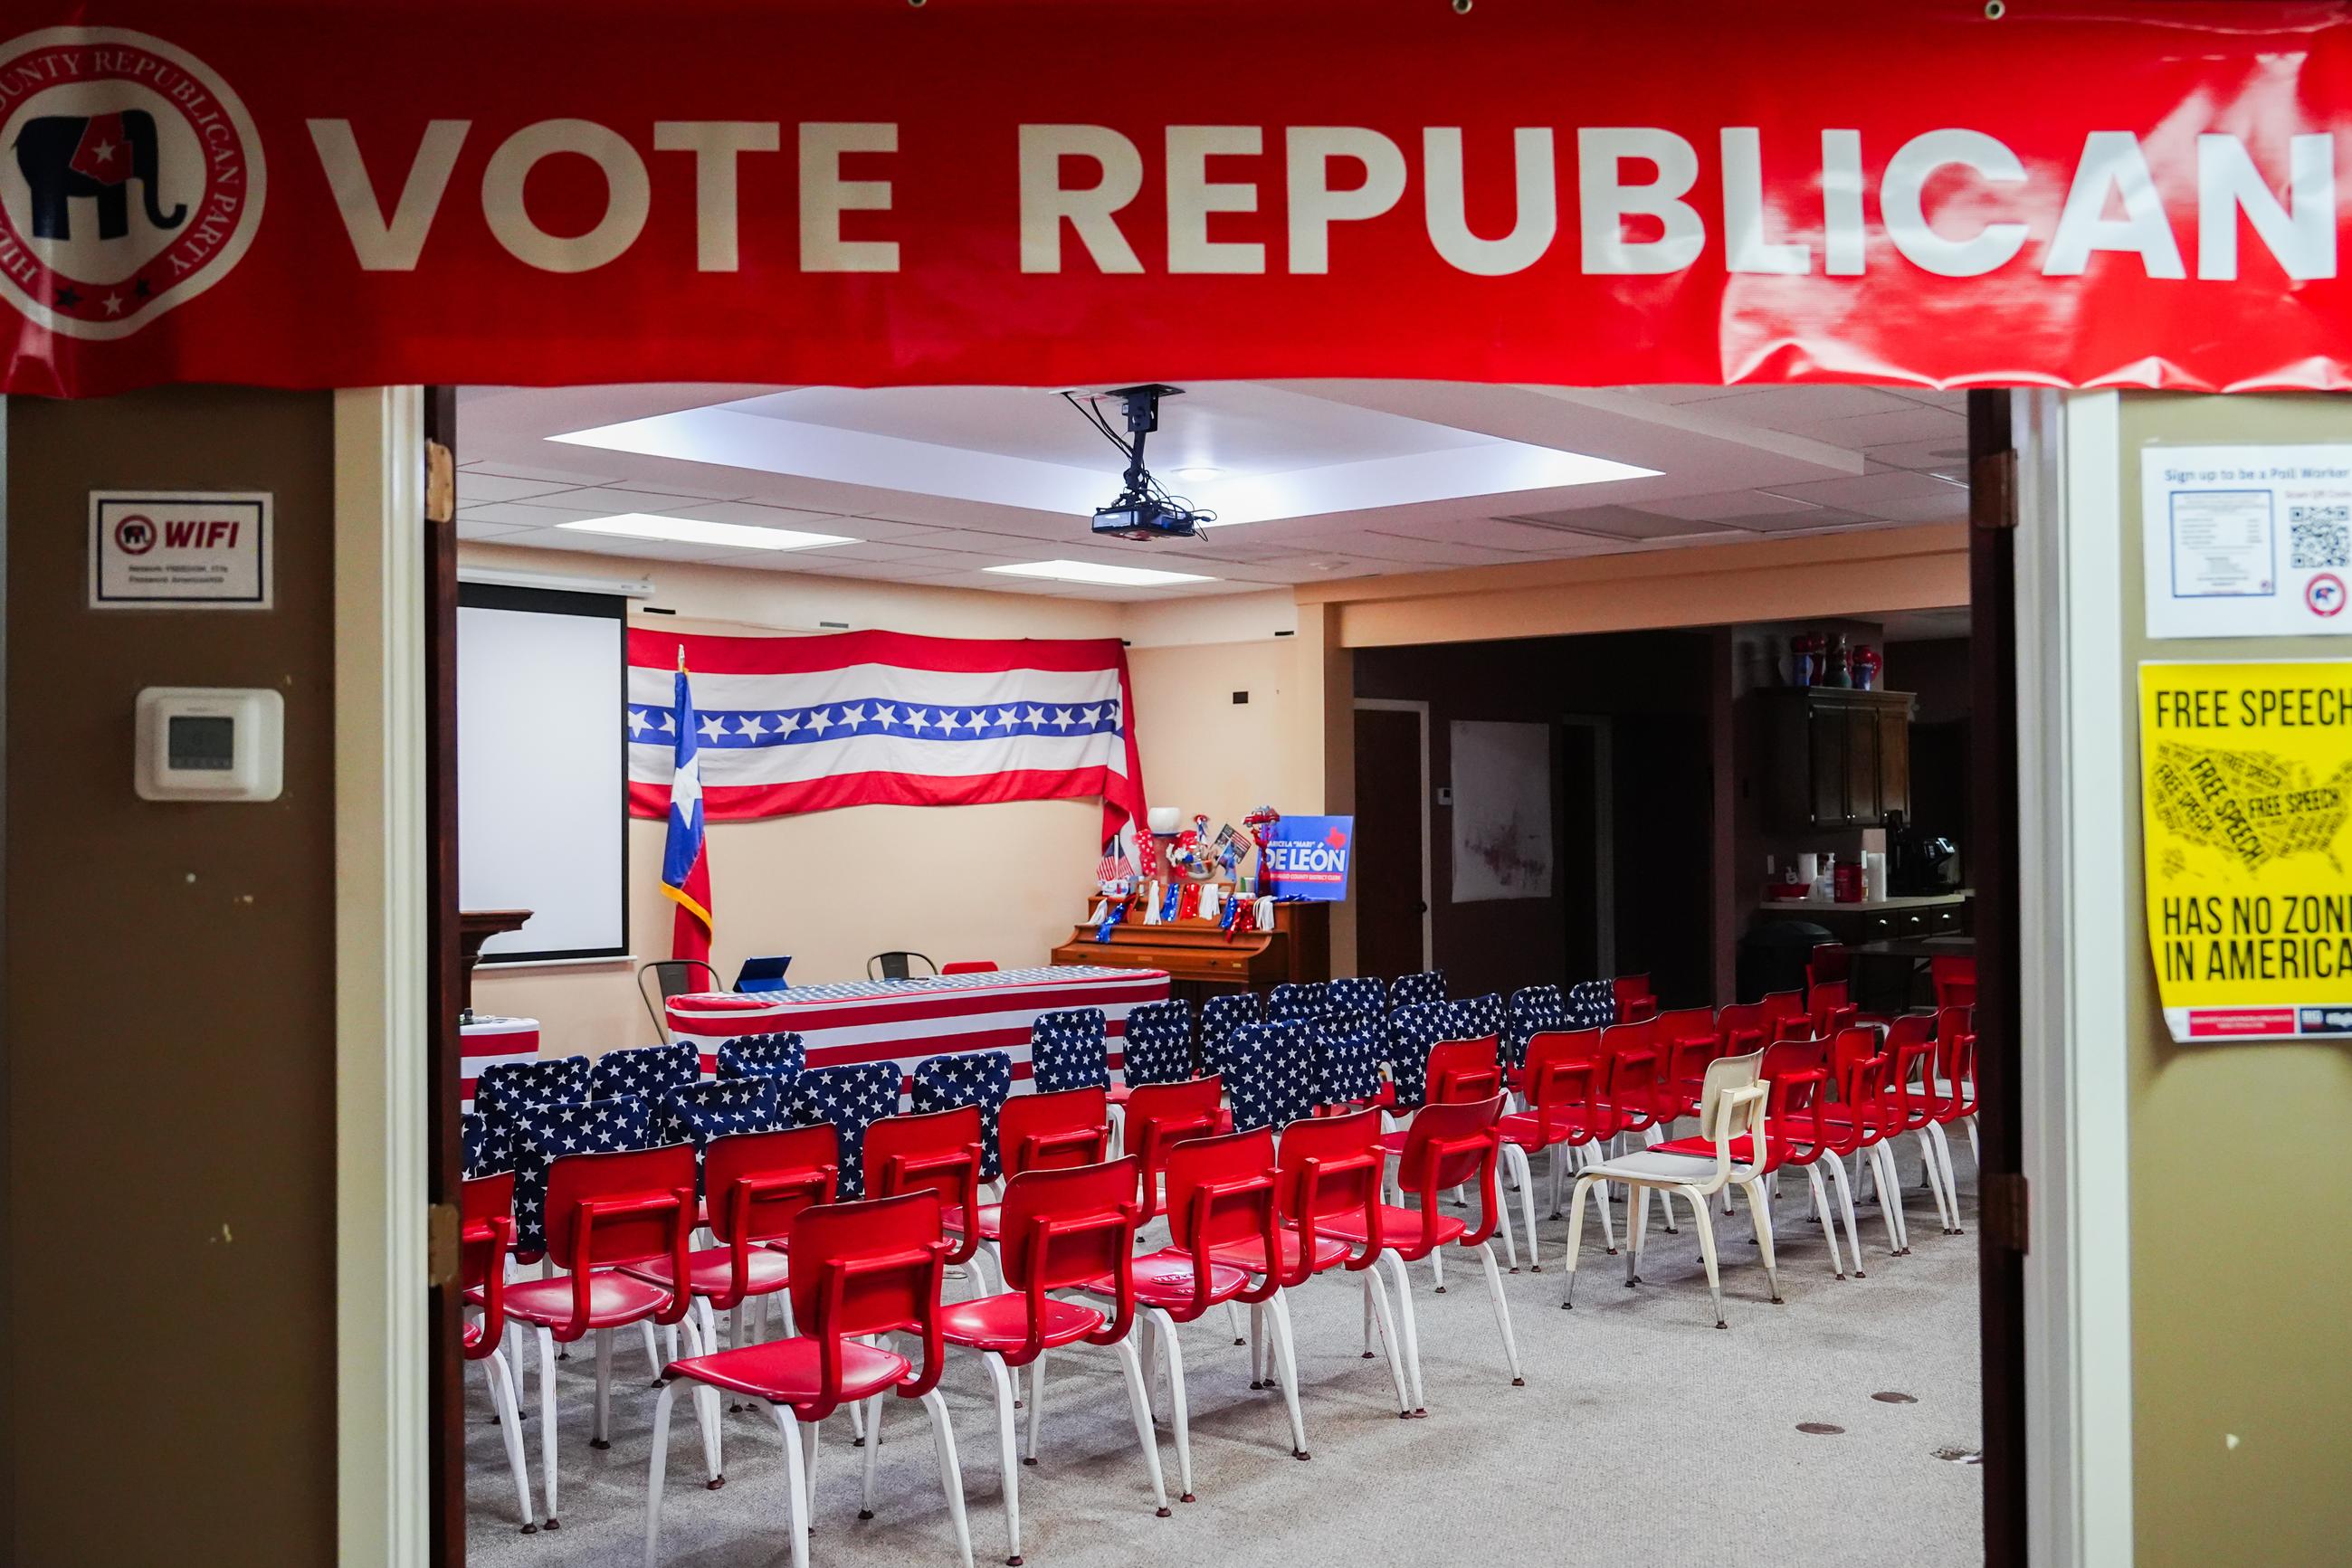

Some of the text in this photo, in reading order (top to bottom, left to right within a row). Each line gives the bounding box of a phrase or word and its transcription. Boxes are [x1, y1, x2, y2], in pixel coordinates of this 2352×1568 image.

[94, 51, 240, 191] REPUBLICAN
[167, 192, 238, 276] PARTY
[305, 118, 2337, 280] VOTE REPUBLICAN
[2164, 467, 2349, 483] Sign up to be a Poll Worker
[164, 520, 240, 548] WIFI
[2156, 688, 2352, 728] FREE SPEECH
[2155, 763, 2184, 794] FREE
[2177, 791, 2214, 832] SPEECH
[2189, 757, 2228, 803] FREE
[2214, 798, 2265, 864] SPEECH
[2247, 788, 2341, 819] FREE SPEECH
[1265, 841, 1346, 872] DE LEÓN
[2164, 895, 2352, 936] HAS NO ZON
[2166, 937, 2352, 982] IN AMERICA
